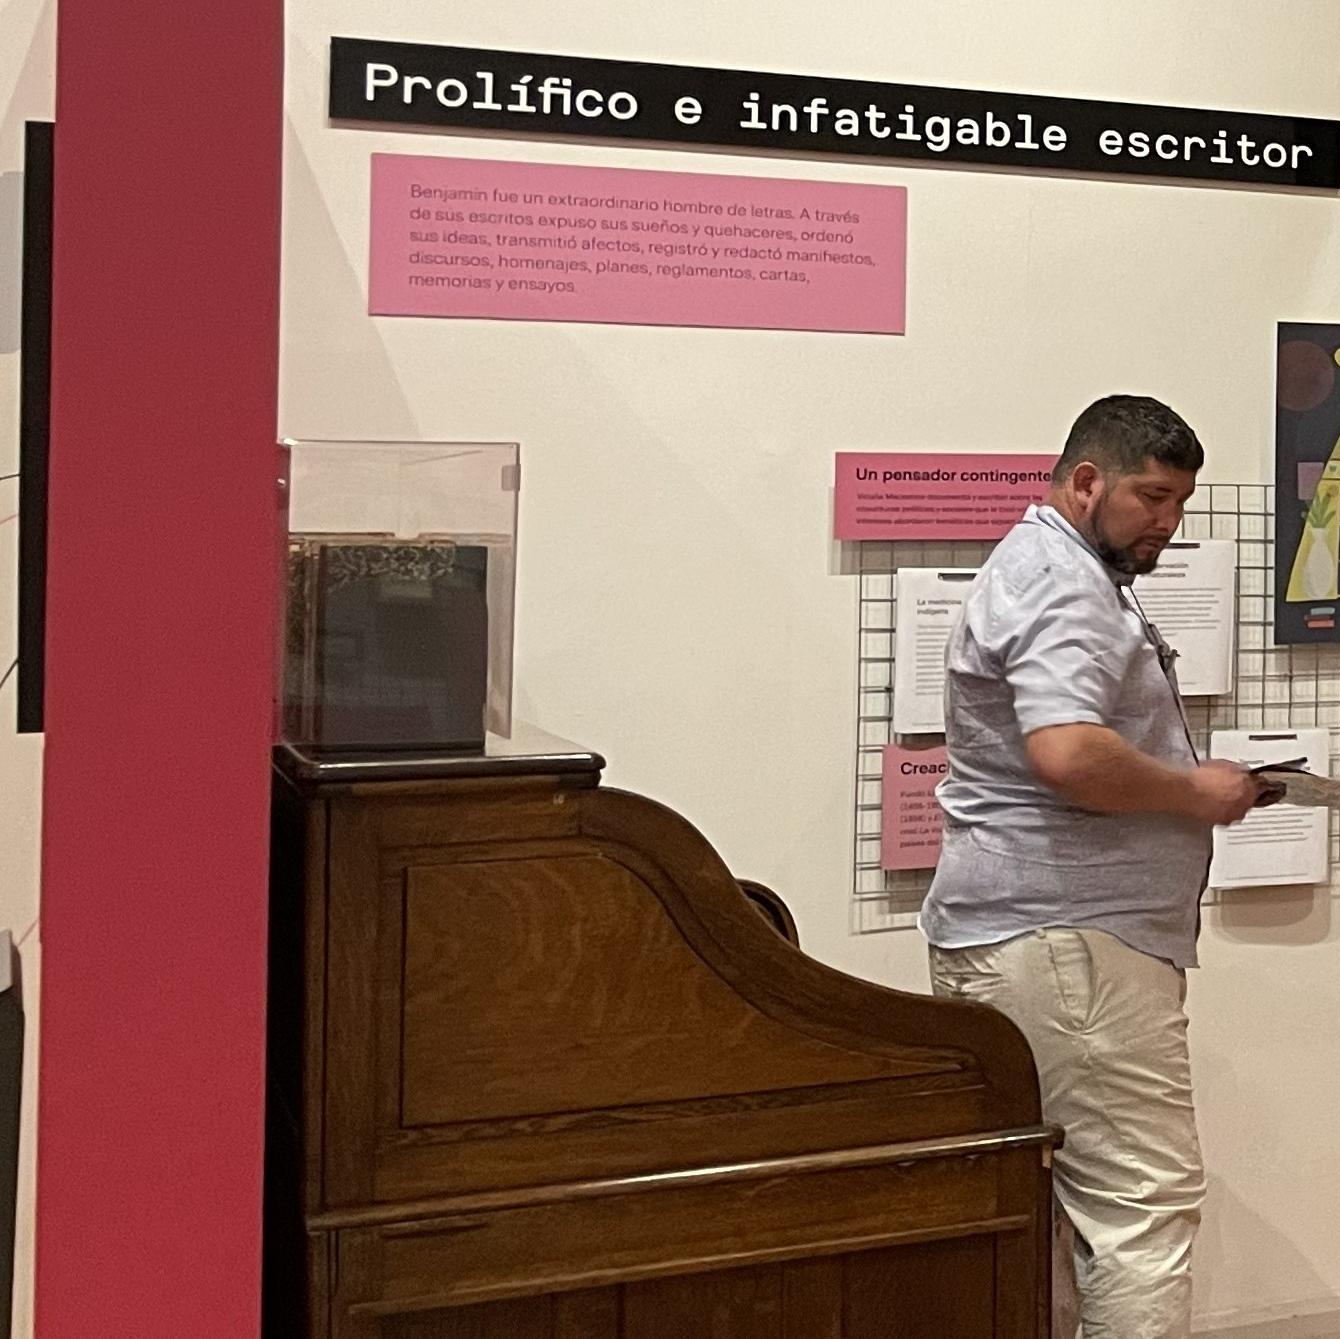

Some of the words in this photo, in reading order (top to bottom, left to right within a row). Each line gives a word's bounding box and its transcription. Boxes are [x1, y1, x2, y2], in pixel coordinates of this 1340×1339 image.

[366, 63, 638, 121] Prolífico
[674, 96, 702, 124] e
[739, 93, 1067, 153] infatigable
[1099, 129, 1313, 169] escritor
[493, 188, 519, 204] fue
[523, 193, 544, 205] un
[548, 195, 659, 212] extraordinario
[663, 200, 723, 215] hombre
[727, 204, 747, 216] de
[751, 205, 795, 220] letras.
[800, 208, 811, 220] A
[815, 209, 860, 224] través
[409, 206, 432, 220] de
[435, 210, 465, 222] sus
[469, 211, 534, 225] escritos
[538, 214, 597, 230] expuso
[601, 218, 628, 231] sus
[631, 219, 692, 235] sueños
[692, 224, 701, 237] y
[704, 225, 798, 241] quehaceres,
[801, 229, 854, 244] ordenó
[409, 230, 439, 243] sus
[442, 230, 491, 247] ideas,
[496, 233, 577, 249] transmitió
[581, 237, 645, 254] afectos,
[648, 241, 708, 257] registró
[711, 246, 719, 259] y
[724, 245, 783, 260] redactó
[408, 251, 494, 269] discursos,
[498, 254, 592, 273] homenajes,
[595, 259, 652, 276] planes,
[656, 263, 756, 281] reglamentos,
[759, 270, 811, 284] cartas,
[408, 273, 491, 290] memorias
[496, 278, 504, 291] y
[856, 468, 878, 481] Un
[883, 469, 956, 483] pensador
[960, 470, 1052, 484] contingente
[900, 762, 947, 775] Creac
